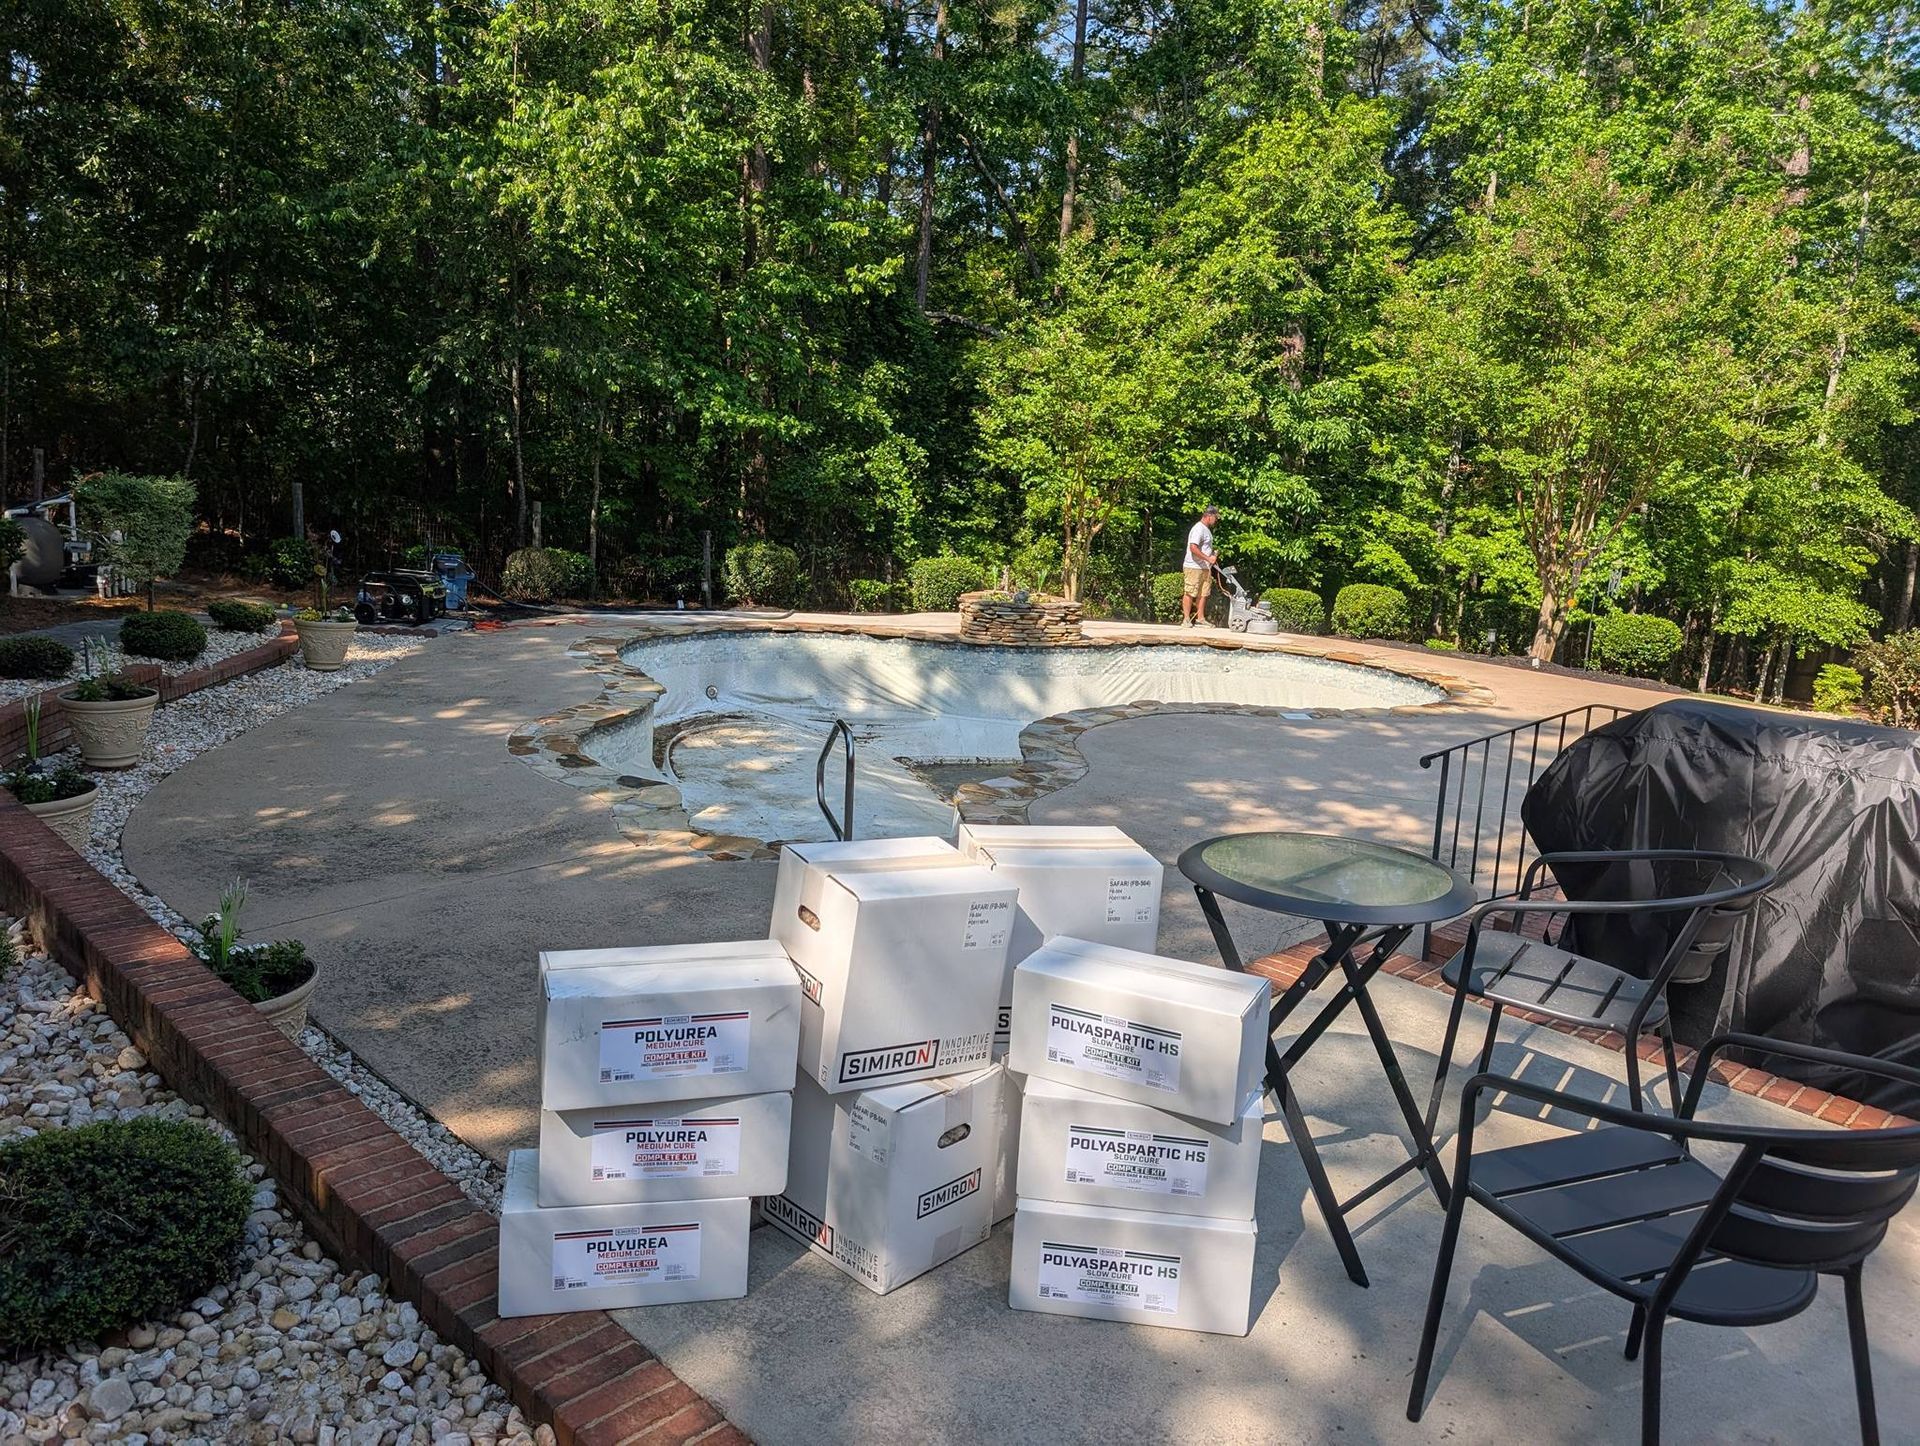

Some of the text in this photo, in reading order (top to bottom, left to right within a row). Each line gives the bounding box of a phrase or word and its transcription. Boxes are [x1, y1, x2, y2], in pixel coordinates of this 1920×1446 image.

[634, 1026, 717, 1044] POLYUREA
[942, 1033, 990, 1050] INNOVATIVE
[1051, 1015, 1179, 1057] POLYASPARTIC HS
[645, 1039, 705, 1050] MEDIUM CURE
[940, 1044, 988, 1057] PROTECTIVE
[1091, 1036, 1135, 1054] SLOW CURE
[645, 1050, 704, 1061] COMPLETE KIT
[848, 1040, 987, 1075] SIMIRON COATINGS
[1086, 1047, 1139, 1066] COMPLETE KIT
[626, 1131, 707, 1143] POLYUREA
[636, 1142, 672, 1150] MEDIUM
[1070, 1137, 1206, 1163] POLYASPARTIC HS
[1114, 1153, 1160, 1165] SLOW CURE
[1107, 1163, 1150, 1174] COMPLETE
[922, 1171, 976, 1212] SIMIRON
[770, 1196, 827, 1245] SIMIRON
[586, 1237, 668, 1253] POLYUREA
[836, 1232, 878, 1262] INNOVATIVE
[598, 1250, 632, 1259] MEDIUM
[597, 1261, 641, 1270] COMPLETE
[835, 1251, 877, 1282] COATINGS
[1043, 1253, 1178, 1279] POLYASPARTIC HS
[1086, 1269, 1132, 1280] SLOW CURE
[1080, 1279, 1138, 1292] COMPLETE KIT
